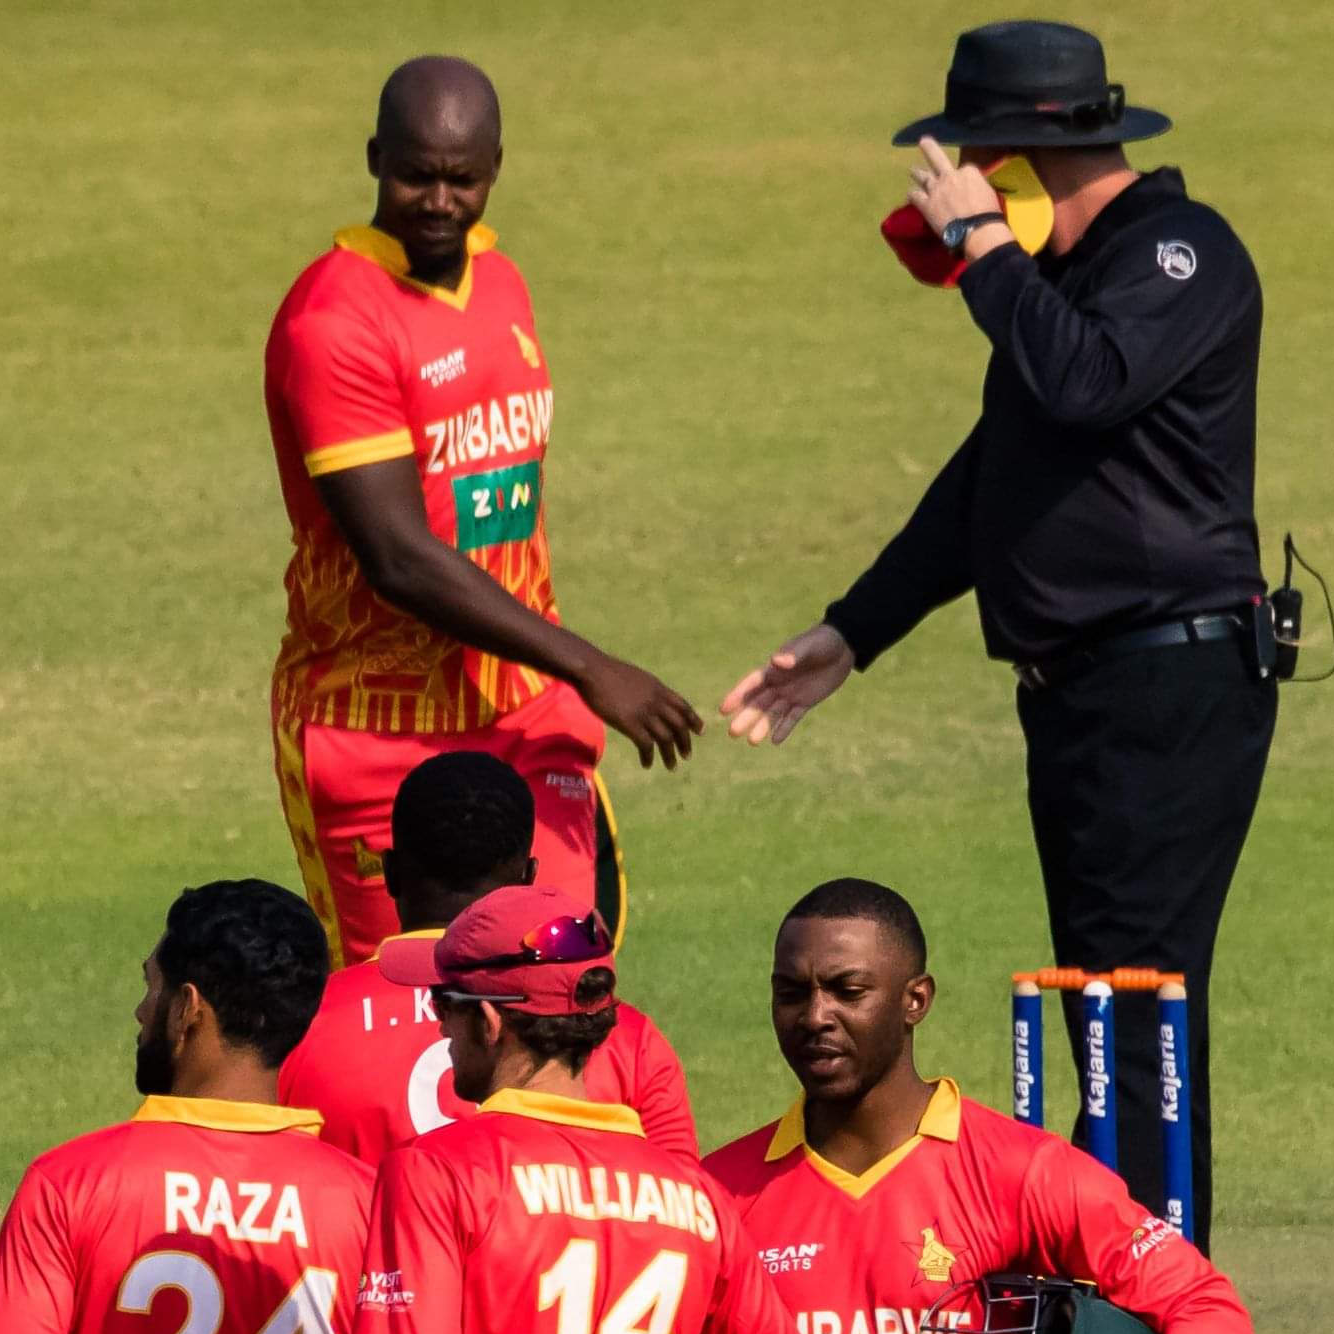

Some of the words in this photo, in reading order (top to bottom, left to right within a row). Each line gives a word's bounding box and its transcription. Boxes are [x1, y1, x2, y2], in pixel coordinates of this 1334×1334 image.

[1014, 1020, 1034, 1118] Kajaria
[1086, 1020, 1109, 1118] Kajaria
[1160, 1023, 1182, 1122] Kajaria
[164, 1171, 308, 1247] RAZA
[512, 1163, 717, 1242] WILLIAMS
